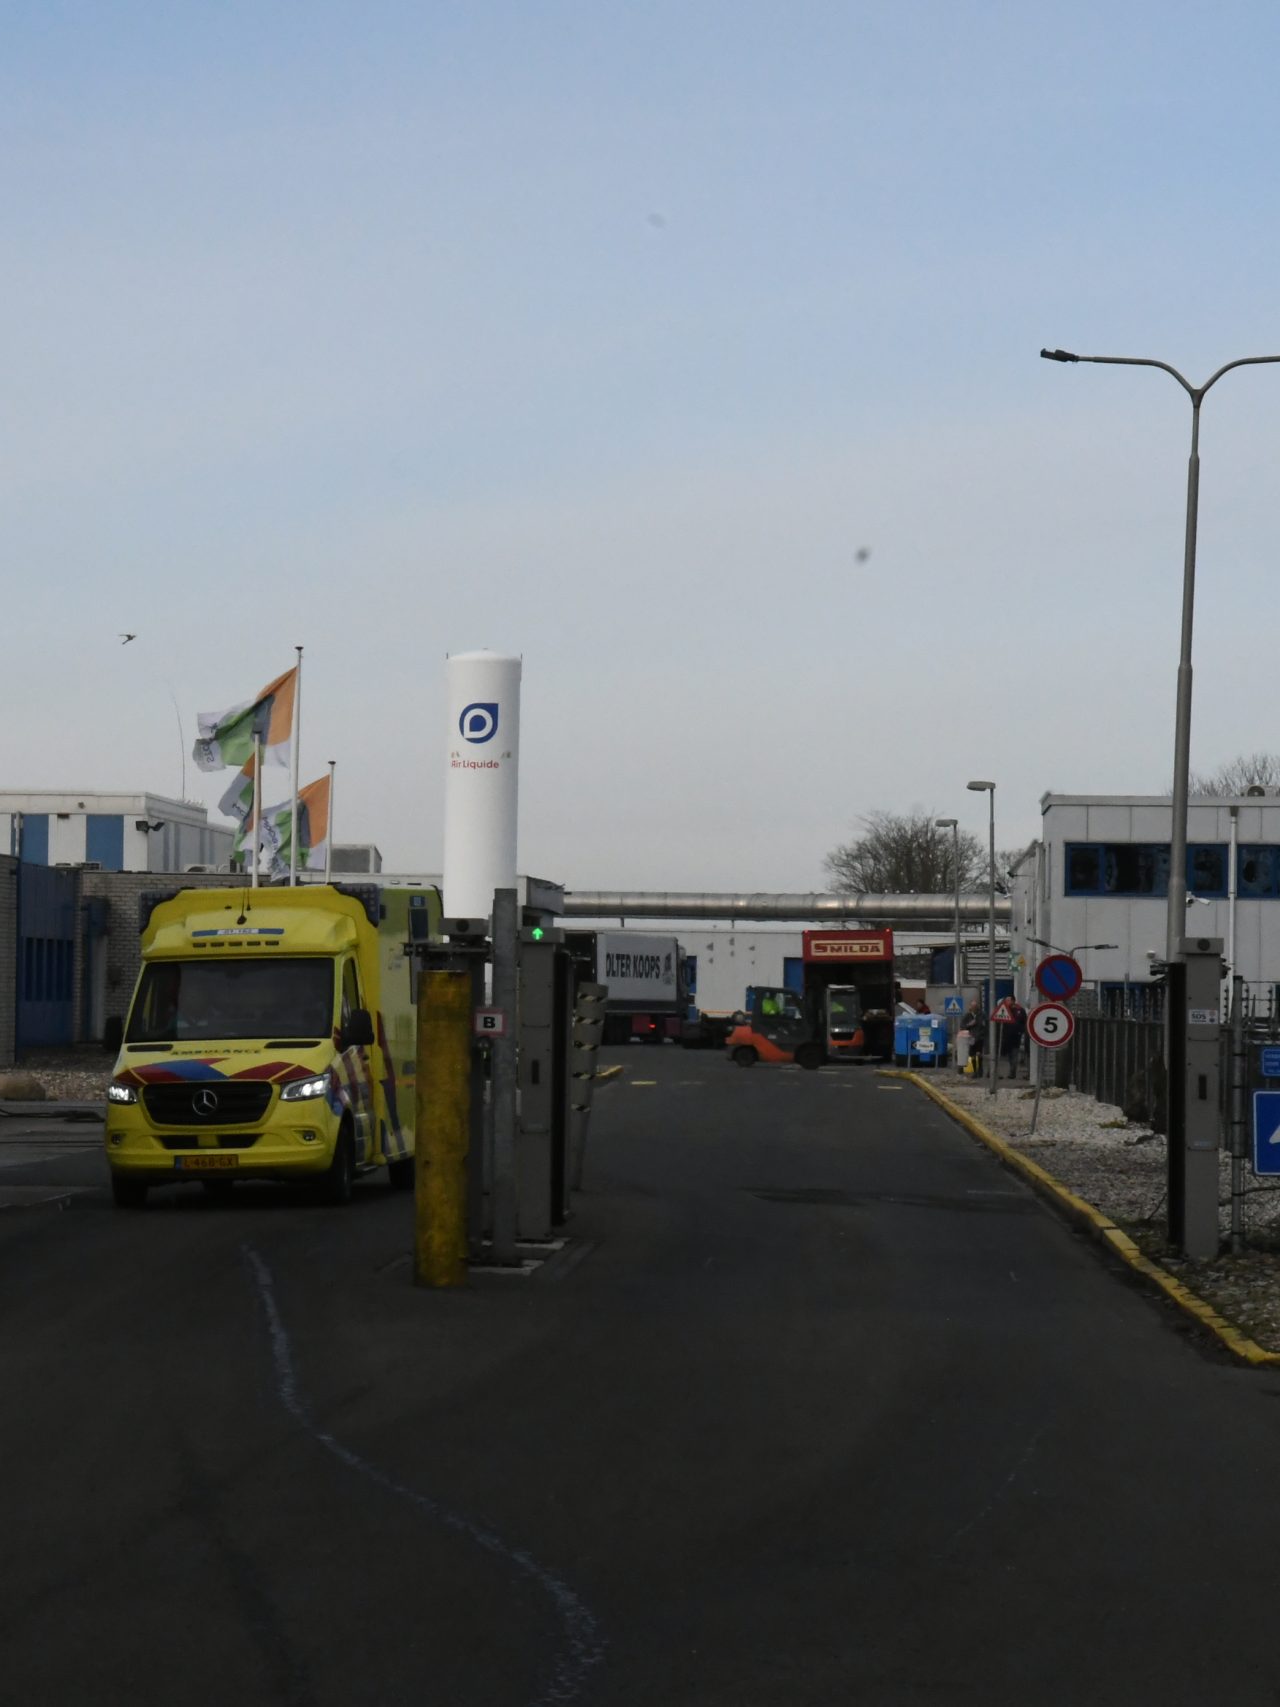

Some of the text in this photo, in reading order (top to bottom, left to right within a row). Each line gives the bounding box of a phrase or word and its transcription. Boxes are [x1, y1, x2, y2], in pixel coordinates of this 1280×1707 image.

[463, 760, 500, 770] Liquide
[814, 942, 880, 953] SMILDA
[606, 953, 660, 979] OLTER KOOPS
[483, 1016, 495, 1028] B
[1043, 1016, 1058, 1033] 5
[170, 1048, 261, 1056] AMBULANCE
